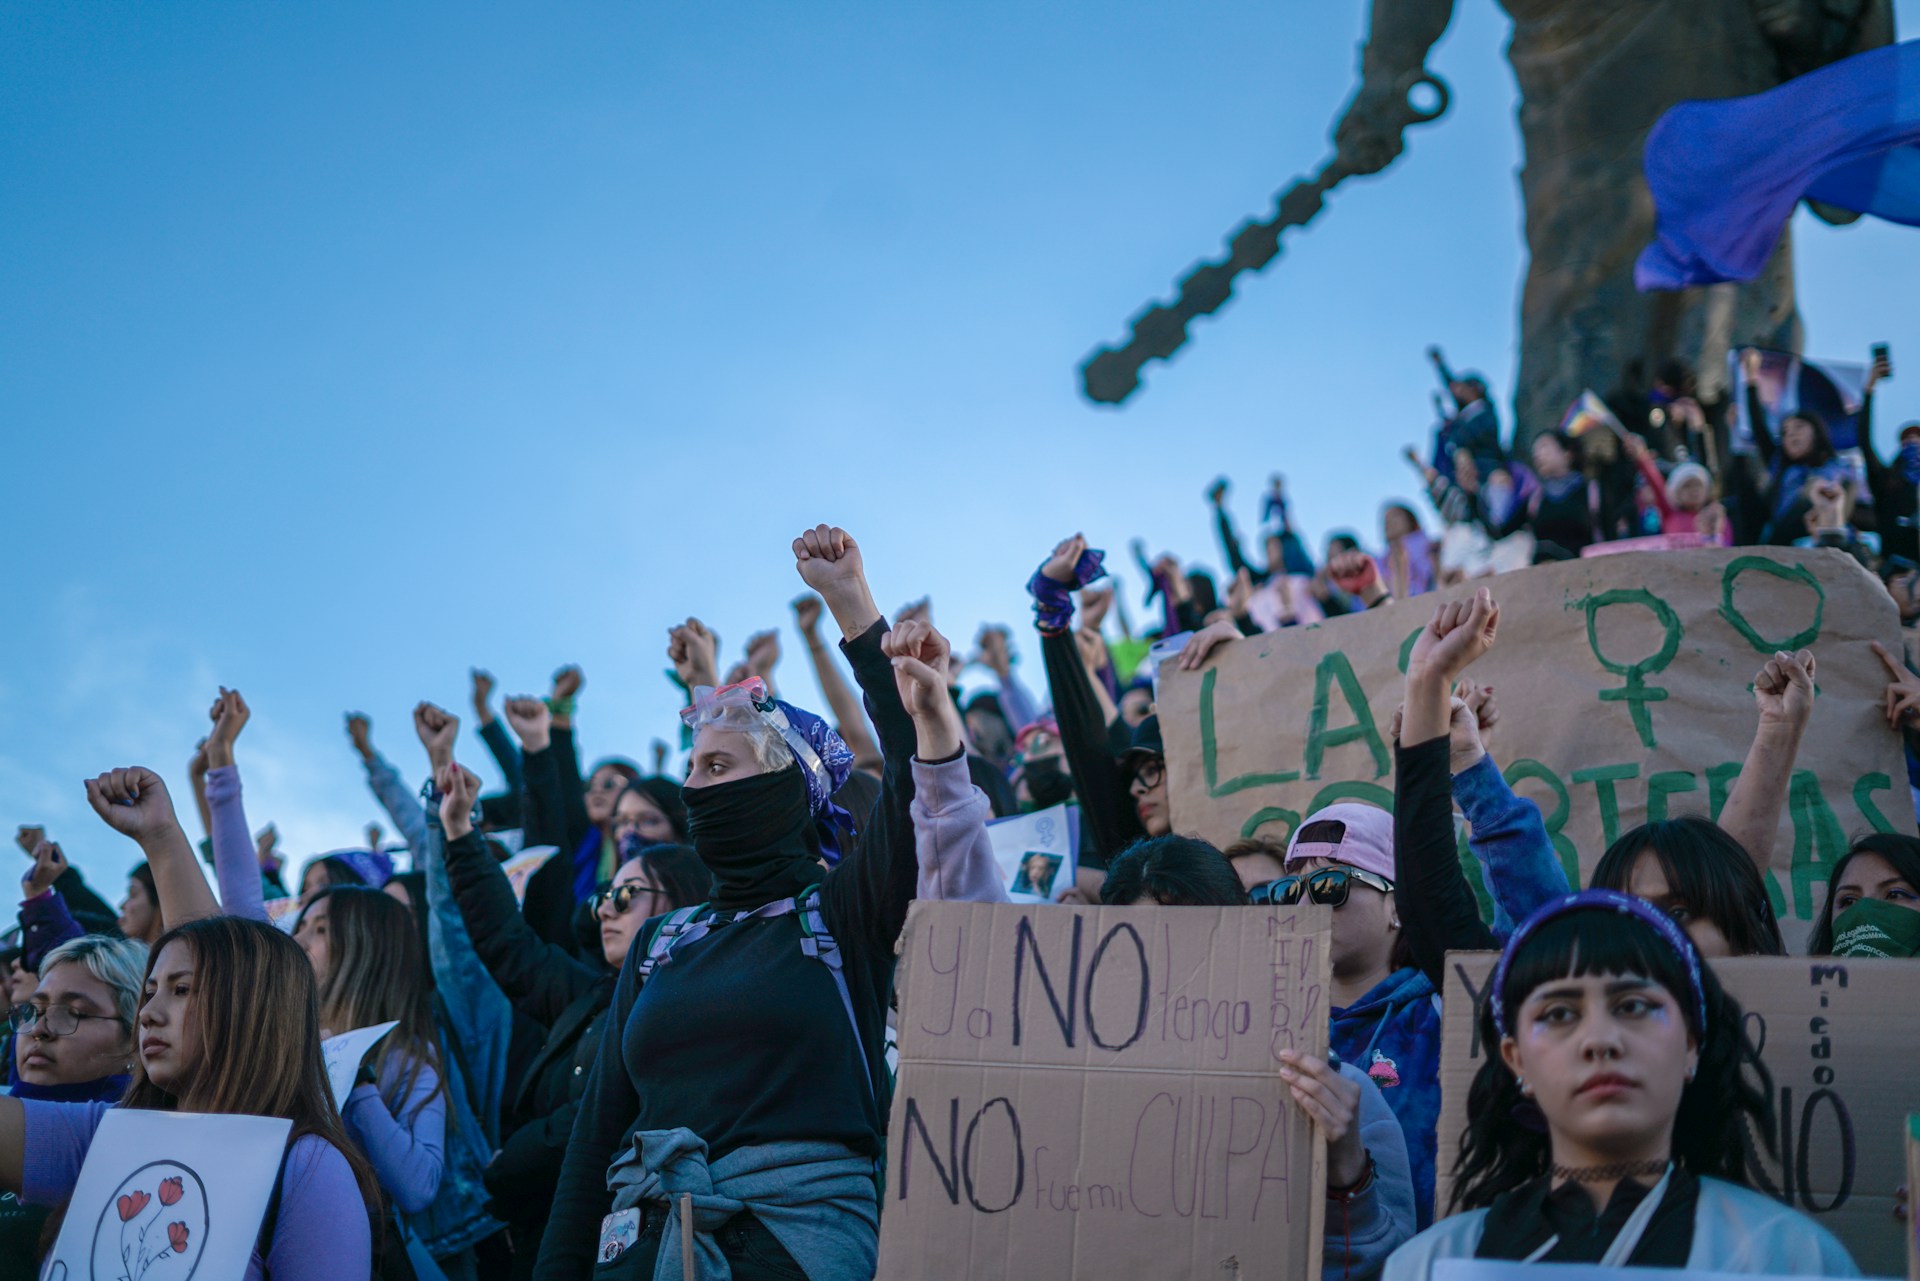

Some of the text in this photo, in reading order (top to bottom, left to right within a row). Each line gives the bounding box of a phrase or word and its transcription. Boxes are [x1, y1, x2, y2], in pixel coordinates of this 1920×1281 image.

[1012, 914, 1150, 1052] NO
[1159, 923, 1250, 1060] tengo
[1267, 914, 1296, 1063] MIEDO
[899, 1096, 1025, 1214] NO
[1128, 1091, 1291, 1224] CULPA
